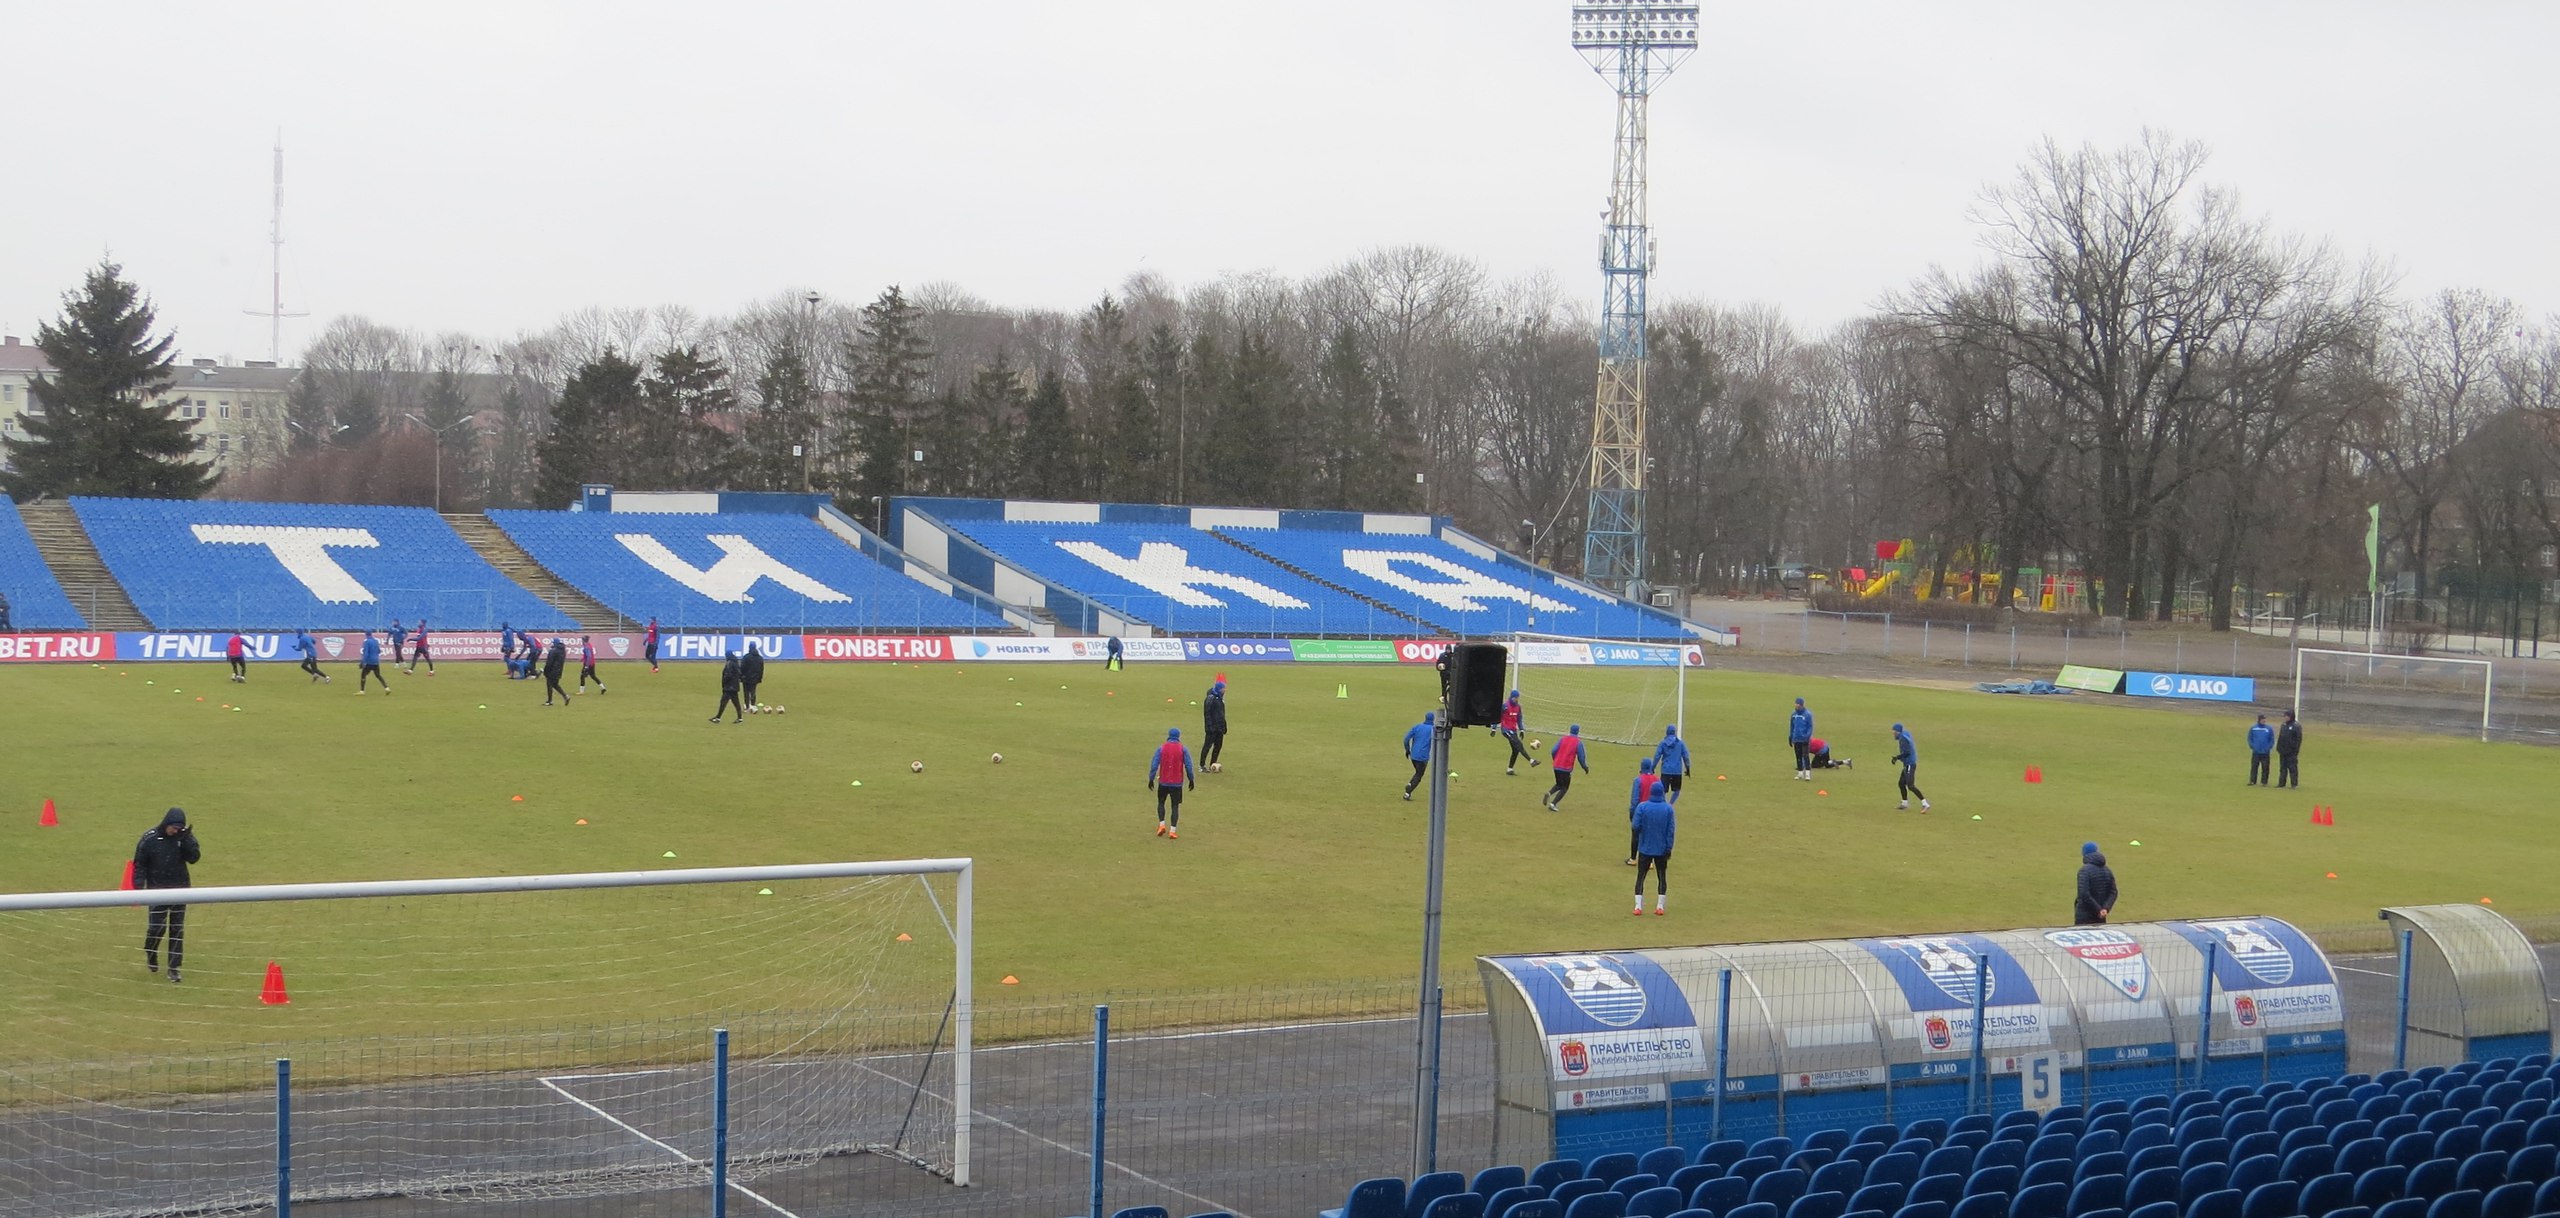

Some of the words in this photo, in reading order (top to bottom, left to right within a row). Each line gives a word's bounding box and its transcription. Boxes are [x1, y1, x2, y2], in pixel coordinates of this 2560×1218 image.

[814, 638, 941, 658] FONBET.RU
[996, 644, 1050, 654] НОВАТЭК
[1087, 641, 1180, 650] ПРАТЕЛЬСТВО
[1610, 648, 1640, 660] JAKO
[2177, 679, 2228, 696] JAKO
[2080, 945, 2132, 956] ФОНБЕТ
[2257, 994, 2331, 1010] ПРАВИТЕЛЬСТВО
[1951, 1015, 2038, 1030] ПРАТЕЛЬСТВО
[1590, 1039, 1691, 1056] ПРАВИТЕЛЬСТВО
[2127, 1048, 2149, 1058] JAKO
[1592, 1054, 1661, 1065] КАЛИНИНГРАДСКОЙ
[1662, 1051, 1694, 1060] ОБЛАСТИ
[1933, 1063, 1957, 1074] JAKO
[1811, 1069, 1869, 1081] ПРАВИТЕЛЬСТВО
[2033, 1058, 2049, 1099] 5
[1726, 1080, 1745, 1091] AKO
[1585, 1086, 1649, 1098] ПРАВИТЕЛЬСТВО
